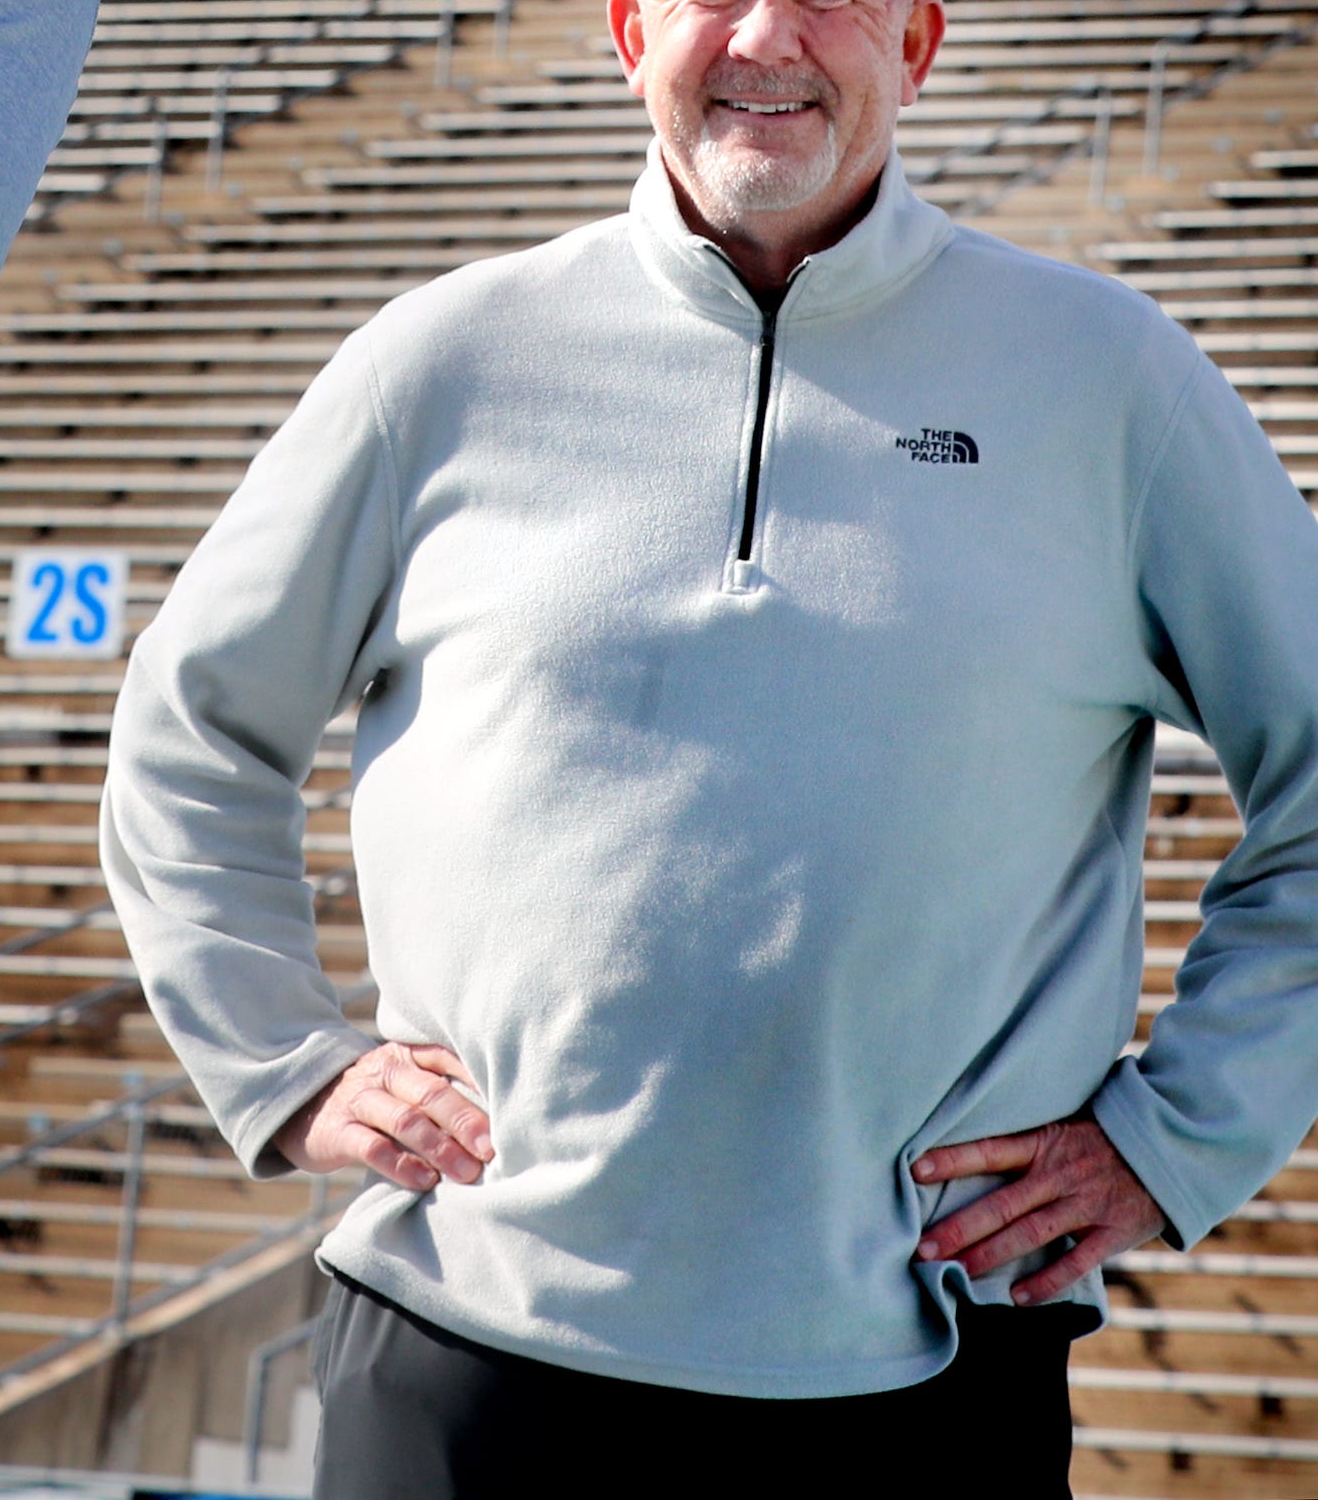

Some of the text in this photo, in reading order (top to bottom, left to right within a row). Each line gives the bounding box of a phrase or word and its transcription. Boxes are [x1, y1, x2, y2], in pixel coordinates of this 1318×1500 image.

[921, 428, 953, 442] THE
[895, 437, 952, 453] NORTH
[911, 451, 951, 464] FACE
[27, 562, 109, 645] 2S
